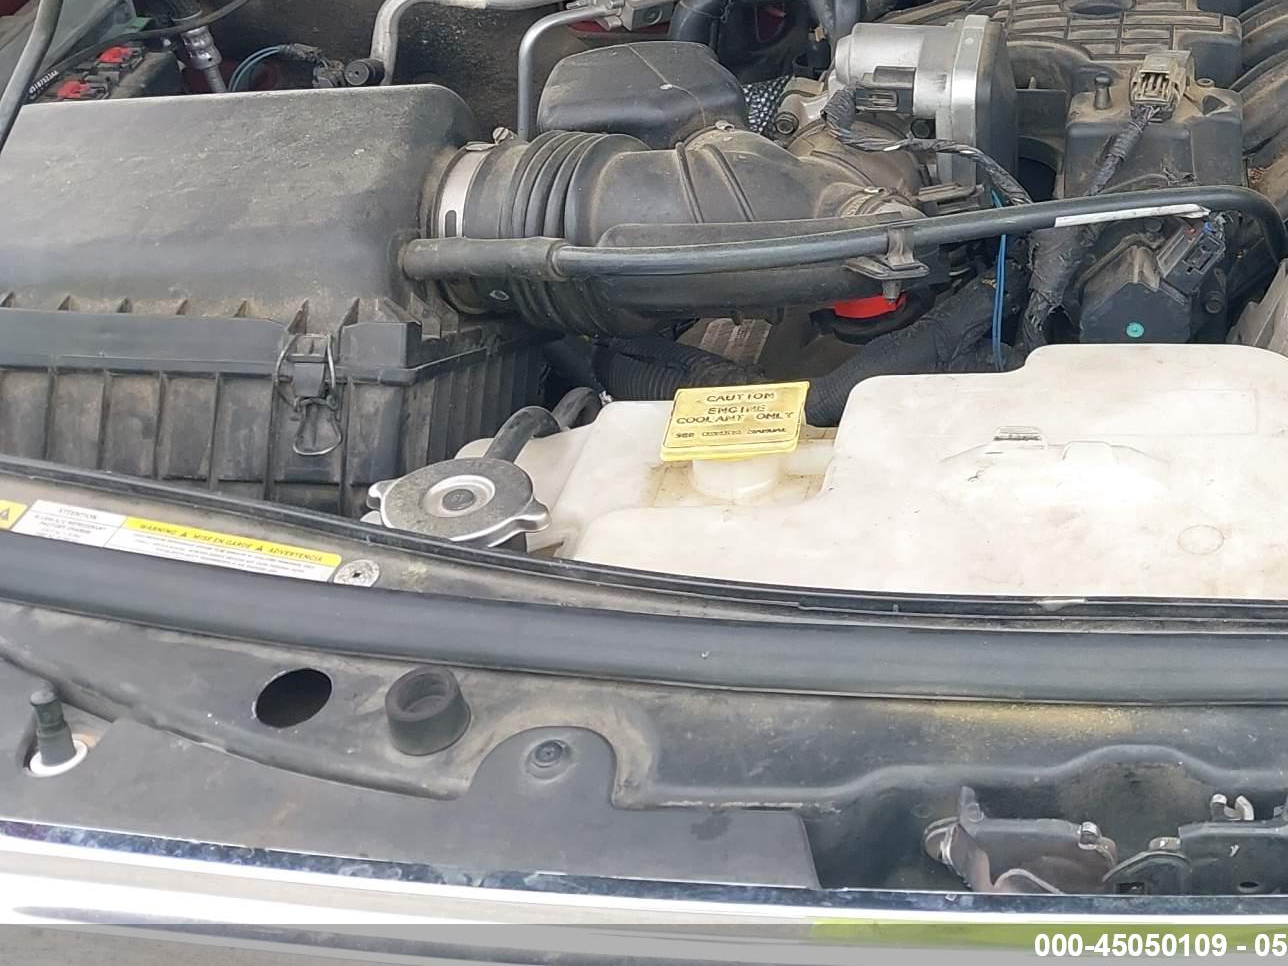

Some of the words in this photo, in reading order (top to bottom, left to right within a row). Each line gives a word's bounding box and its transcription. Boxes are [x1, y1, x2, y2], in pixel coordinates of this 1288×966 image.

[706, 392, 775, 402] CAUTION
[676, 414, 743, 424] COOLANT
[755, 411, 795, 421] ONLY
